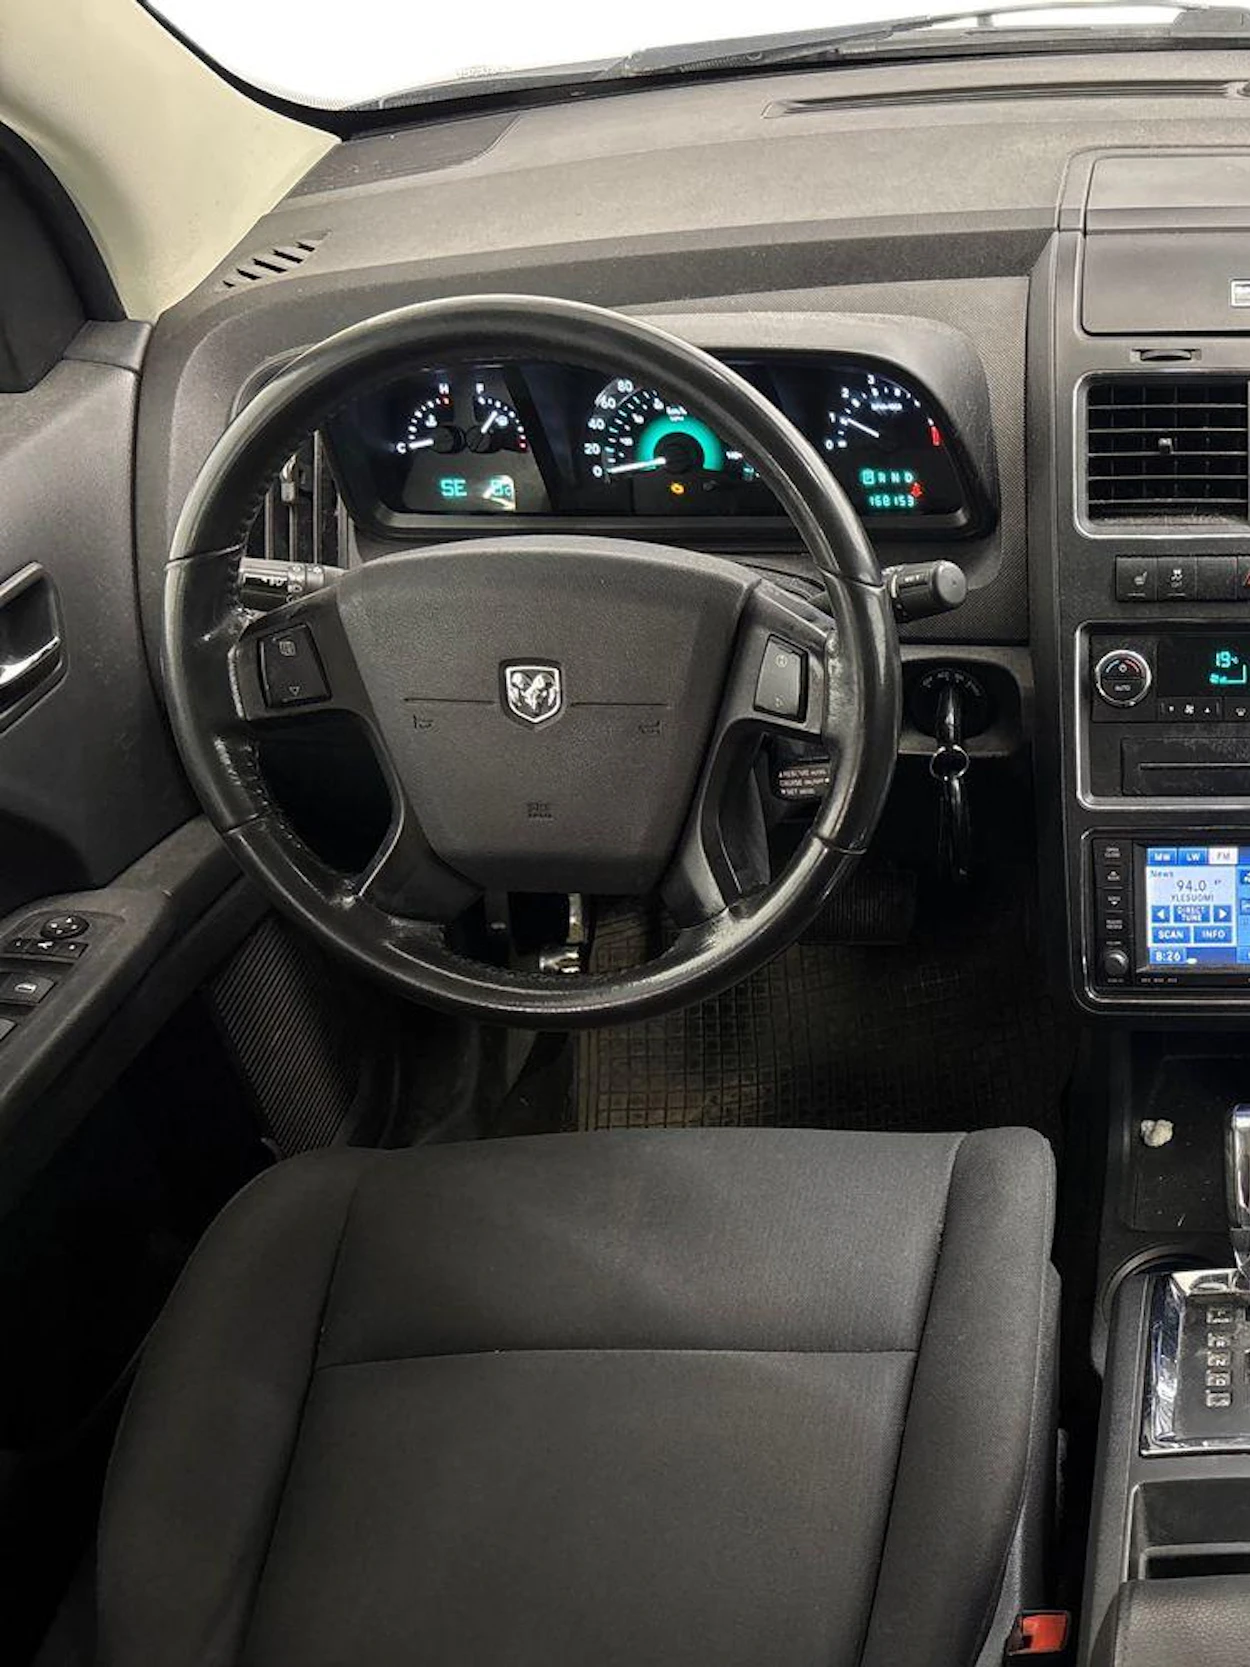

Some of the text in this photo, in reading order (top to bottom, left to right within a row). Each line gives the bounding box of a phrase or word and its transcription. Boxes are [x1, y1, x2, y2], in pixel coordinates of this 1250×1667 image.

[617, 379, 633, 393] 80
[867, 374, 875, 385] 3
[438, 382, 450, 395] H
[841, 387, 850, 399] 2
[600, 396, 616, 410] 60
[587, 418, 606, 431] 40
[395, 442, 407, 455] C
[583, 442, 601, 455] 20
[825, 439, 834, 450] 0
[592, 465, 603, 478] 0
[440, 479, 468, 497] SE
[1186, 853, 1201, 862] LW
[1216, 851, 1231, 860] FM
[1176, 879, 1207, 892] 94.0
[1157, 929, 1184, 940] SCAN
[1202, 929, 1226, 939] INFO
[1155, 951, 1182, 962] 8:26
